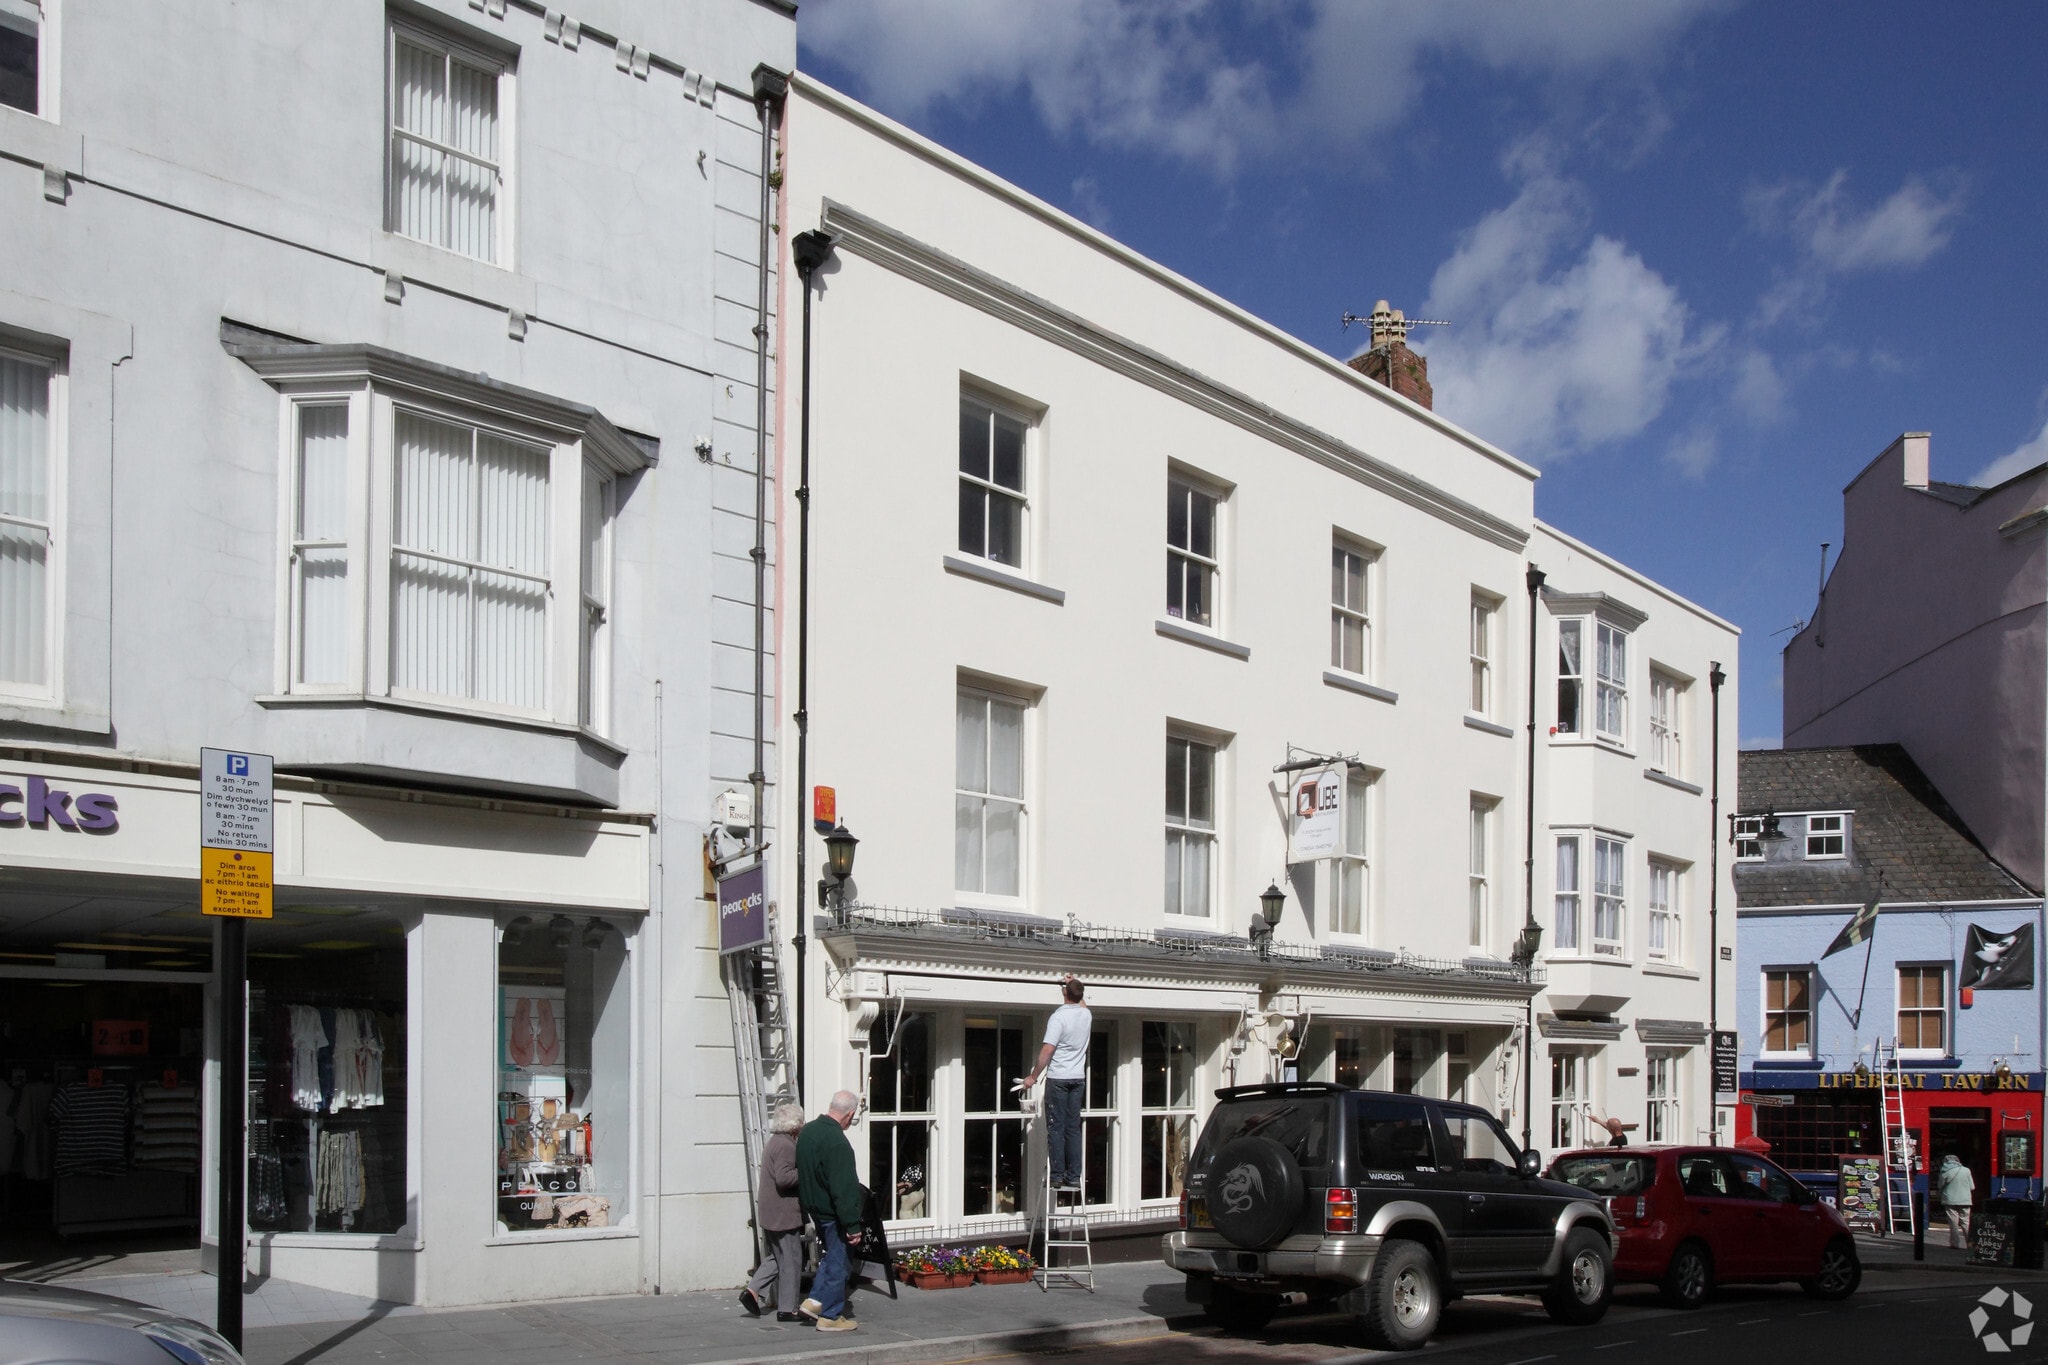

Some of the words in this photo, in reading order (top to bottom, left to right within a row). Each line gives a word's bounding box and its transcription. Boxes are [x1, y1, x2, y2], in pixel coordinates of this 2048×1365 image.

[231, 756, 246, 774] P
[207, 792, 223, 800] Dim
[225, 795, 268, 806] dychwelyd
[1297, 780, 1338, 819] QUBE
[214, 801, 234, 809] fewn
[221, 820, 233, 828] 30
[232, 831, 258, 839] return
[207, 837, 233, 845] within
[235, 839, 247, 847] 30
[249, 841, 268, 849] mins
[217, 878, 244, 887] eithrio
[246, 881, 270, 889] tacsis
[230, 890, 260, 898] waiting
[212, 906, 240, 914] except
[243, 907, 263, 915] taxis
[722, 892, 762, 919] peacocks
[1818, 1073, 1927, 1089] LIFEBOAT
[1368, 1172, 1405, 1181] WAGON
[501, 1180, 624, 1191] PEACOKS
[1977, 1237, 2002, 1250] Abbey
[1978, 1247, 1997, 1259] Shop
